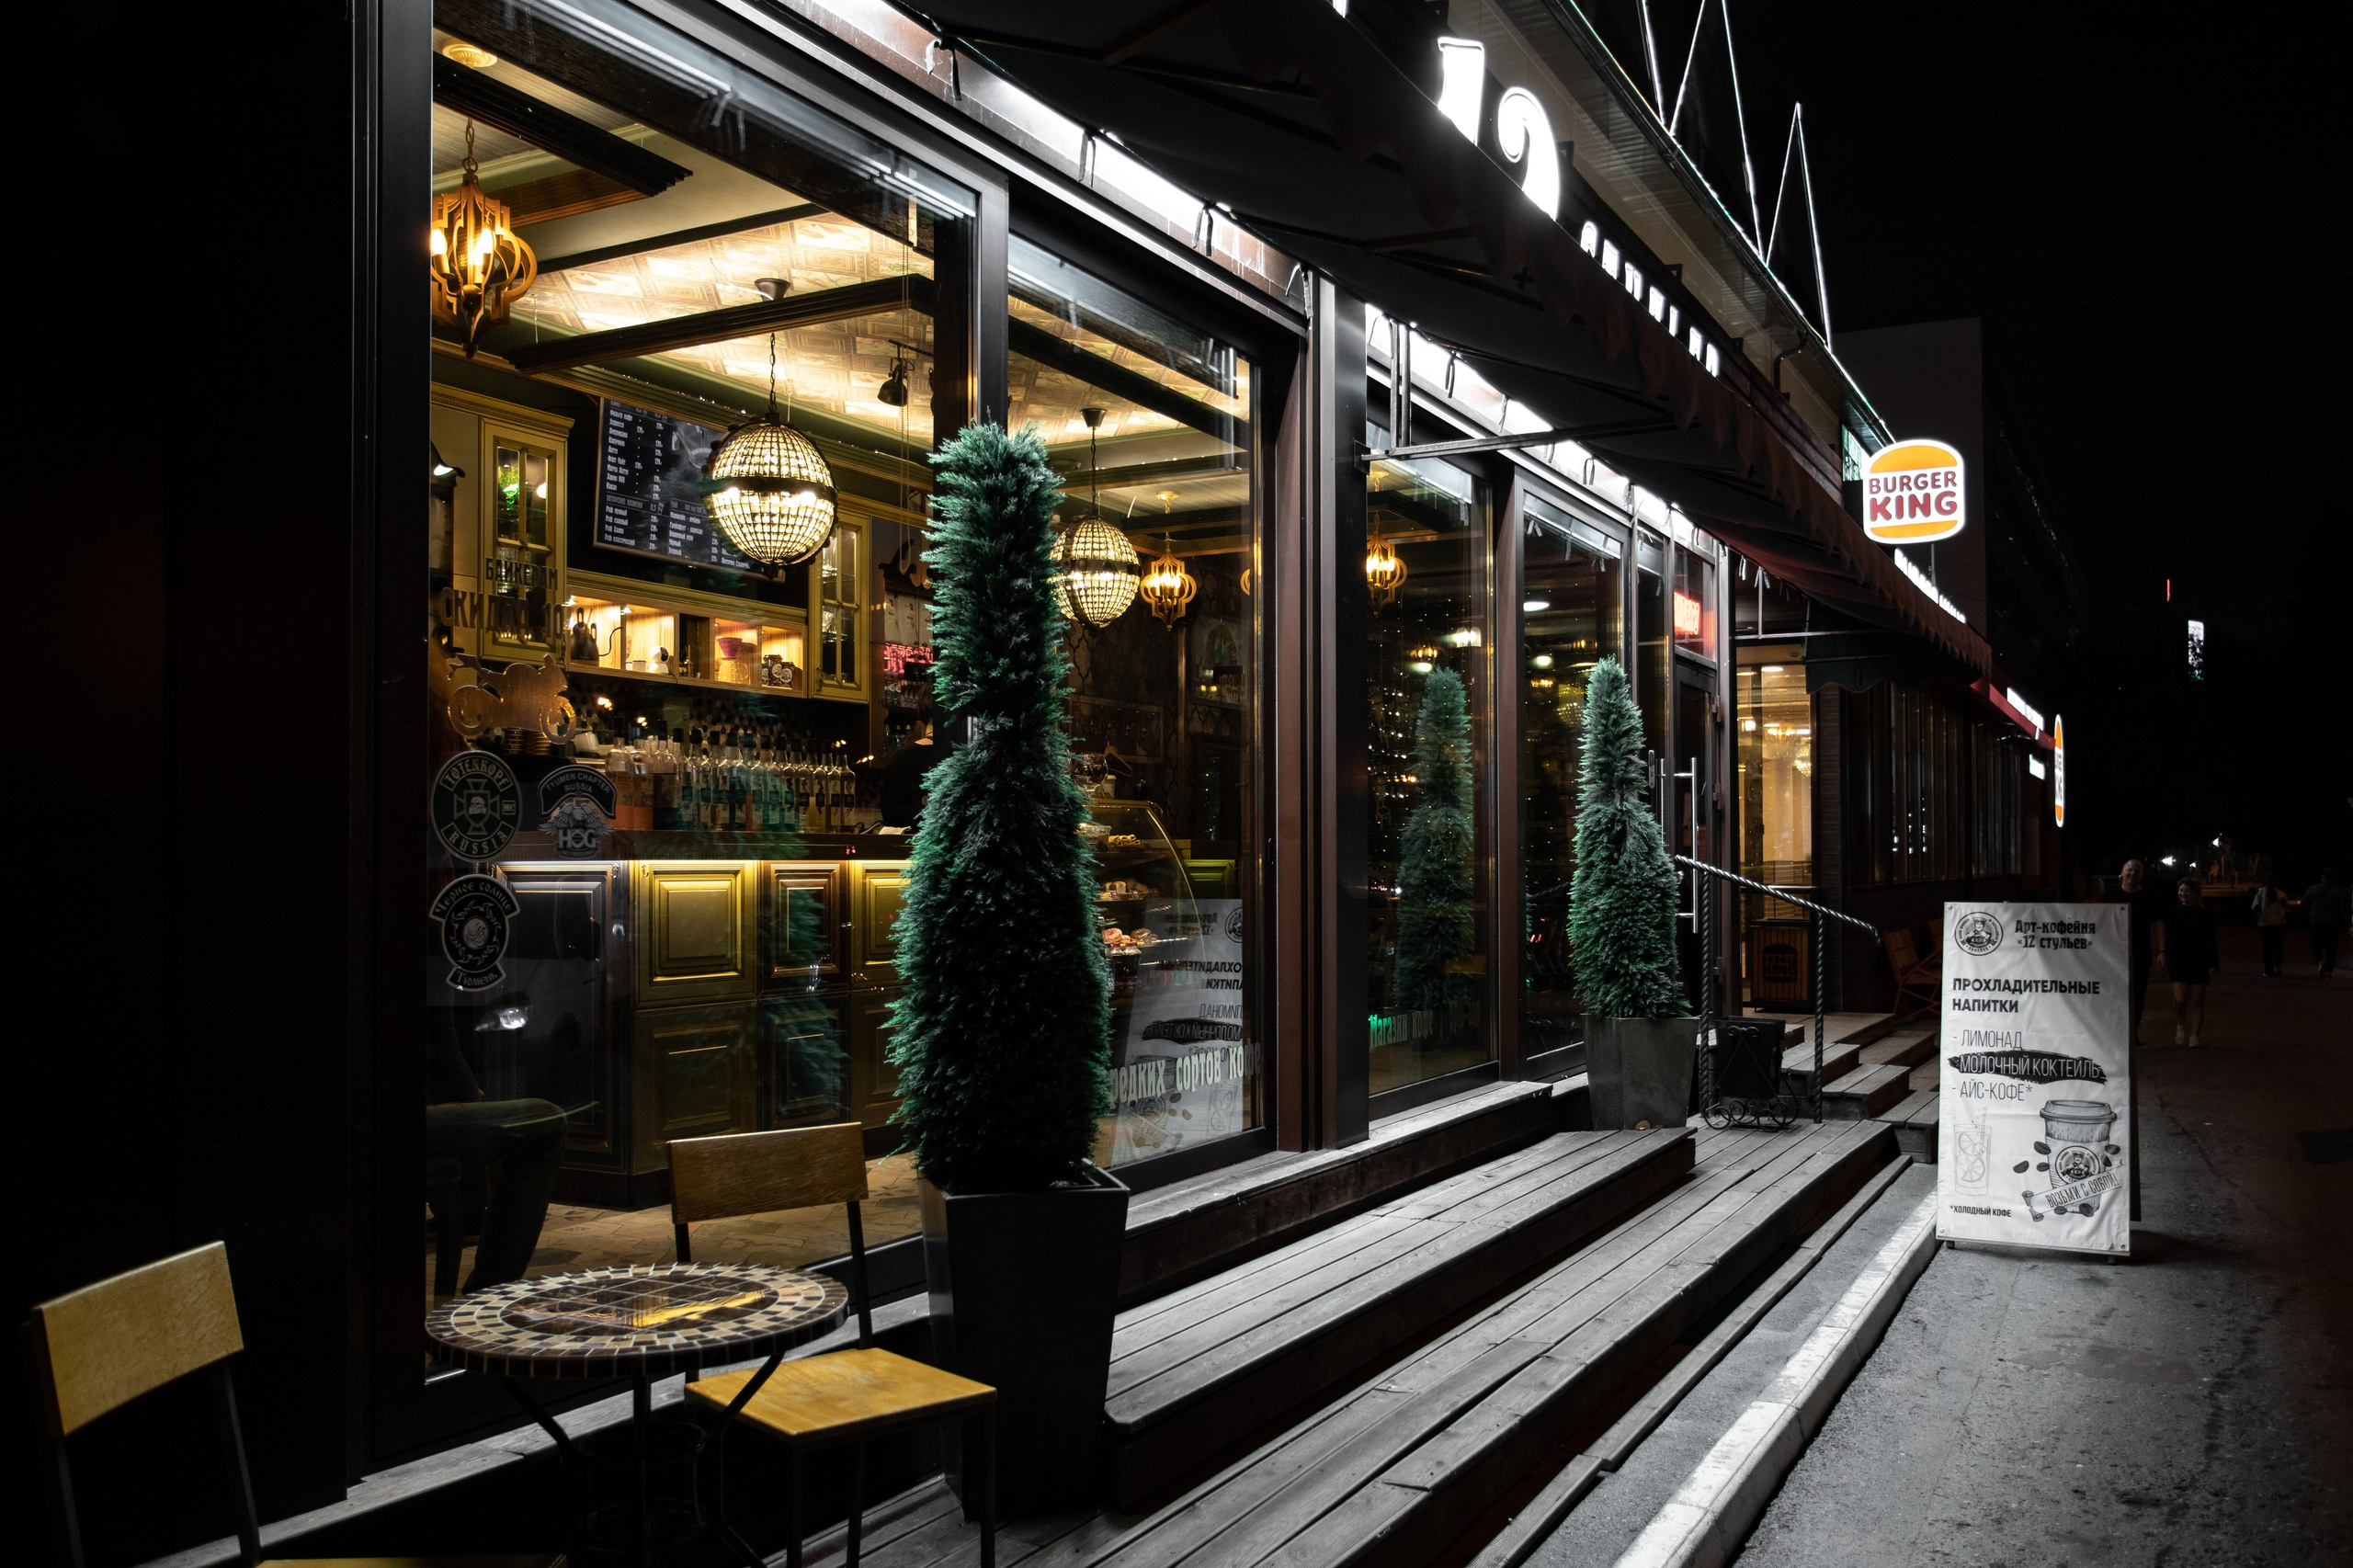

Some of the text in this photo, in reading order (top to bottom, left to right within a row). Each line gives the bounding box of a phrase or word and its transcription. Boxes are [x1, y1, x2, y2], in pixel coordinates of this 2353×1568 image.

[1869, 471, 1957, 494] BURGER
[1870, 491, 1958, 522] KING
[485, 556, 558, 590] БАЙКЕРАМ
[440, 586, 530, 637] СКИДКА
[444, 757, 511, 787] TOTENKOPF
[546, 773, 610, 794] TYUMEN CHAPTER
[564, 782, 593, 793] RUSSIA
[449, 830, 508, 855] RUSSIA
[2015, 917, 2096, 935] Арт-кофейня
[2040, 936, 2093, 950] стульев»
[1952, 977, 2100, 995] ПРОХЛАДИТЕЛЬНЫЕ
[1951, 998, 2018, 1014] НАПИТКИ
[1370, 1013, 1408, 1048] Магазин
[1961, 1029, 2022, 1051] ЛИМОНАД
[1176, 1050, 1222, 1092] сортов
[1229, 1038, 1261, 1080] кофе
[1959, 1054, 2031, 1075] МОЛОЧНЫЙ
[2045, 1172, 2120, 1209] ВОЗЬМИ С СОБОЙ!
[1992, 1208, 2011, 1218] КОФЕ
